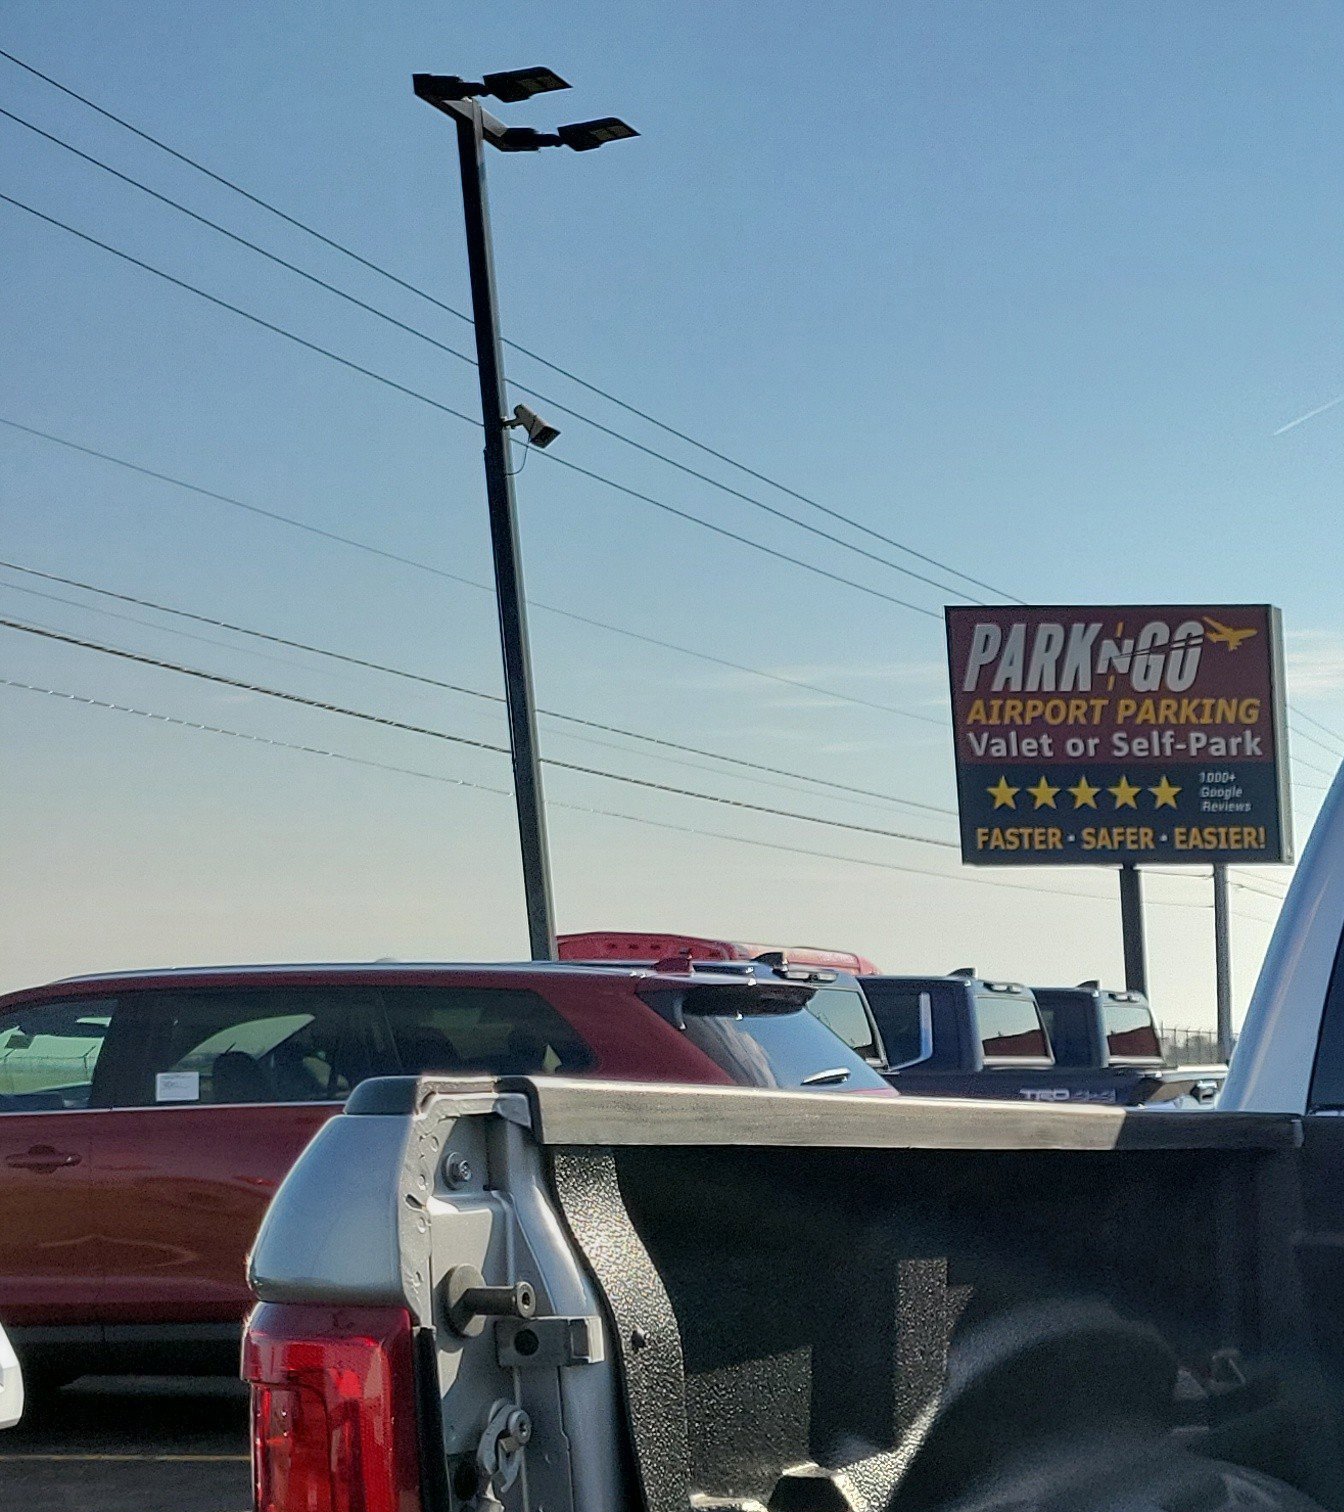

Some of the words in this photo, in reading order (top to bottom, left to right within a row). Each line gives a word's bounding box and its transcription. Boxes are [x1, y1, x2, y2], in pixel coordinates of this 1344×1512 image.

[963, 622, 1103, 692] PARK
[1130, 621, 1205, 693] GO
[967, 699, 1109, 725] AIRPORT
[1116, 699, 1260, 725] PARKING
[967, 731, 1054, 757] Valet
[1066, 736, 1100, 757] or
[1112, 730, 1262, 757] Self-Park
[1198, 771, 1237, 783] 1000+
[1200, 785, 1243, 800] Google
[1202, 801, 1252, 813] Reviews
[976, 827, 1064, 850] FASTER
[1081, 827, 1155, 850] SAFER
[1174, 826, 1266, 850] EASIER!
